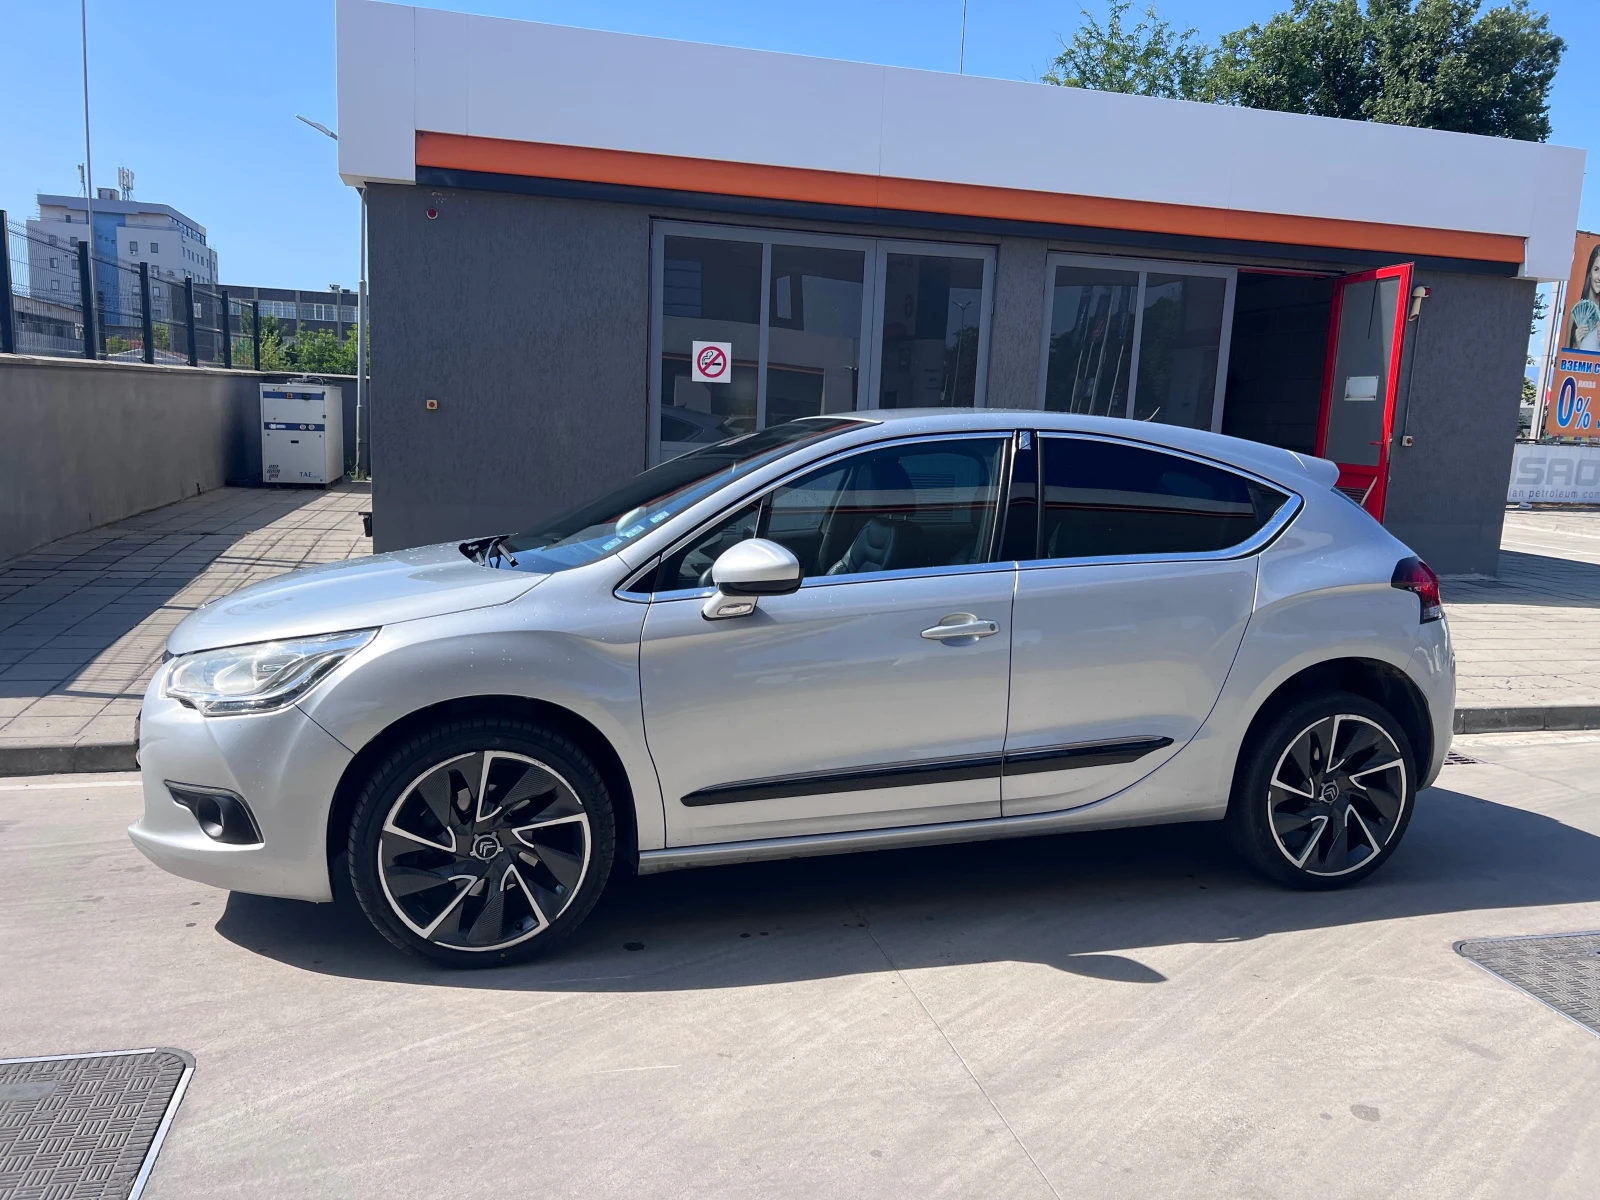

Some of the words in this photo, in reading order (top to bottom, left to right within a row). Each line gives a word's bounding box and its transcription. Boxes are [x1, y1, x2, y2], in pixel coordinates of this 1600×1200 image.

[1560, 359, 1593, 373] ВЗЕМИ
[1557, 376, 1592, 429] 0%
[1511, 457, 1600, 486] SAO
[1529, 489, 1578, 499] petroleum
